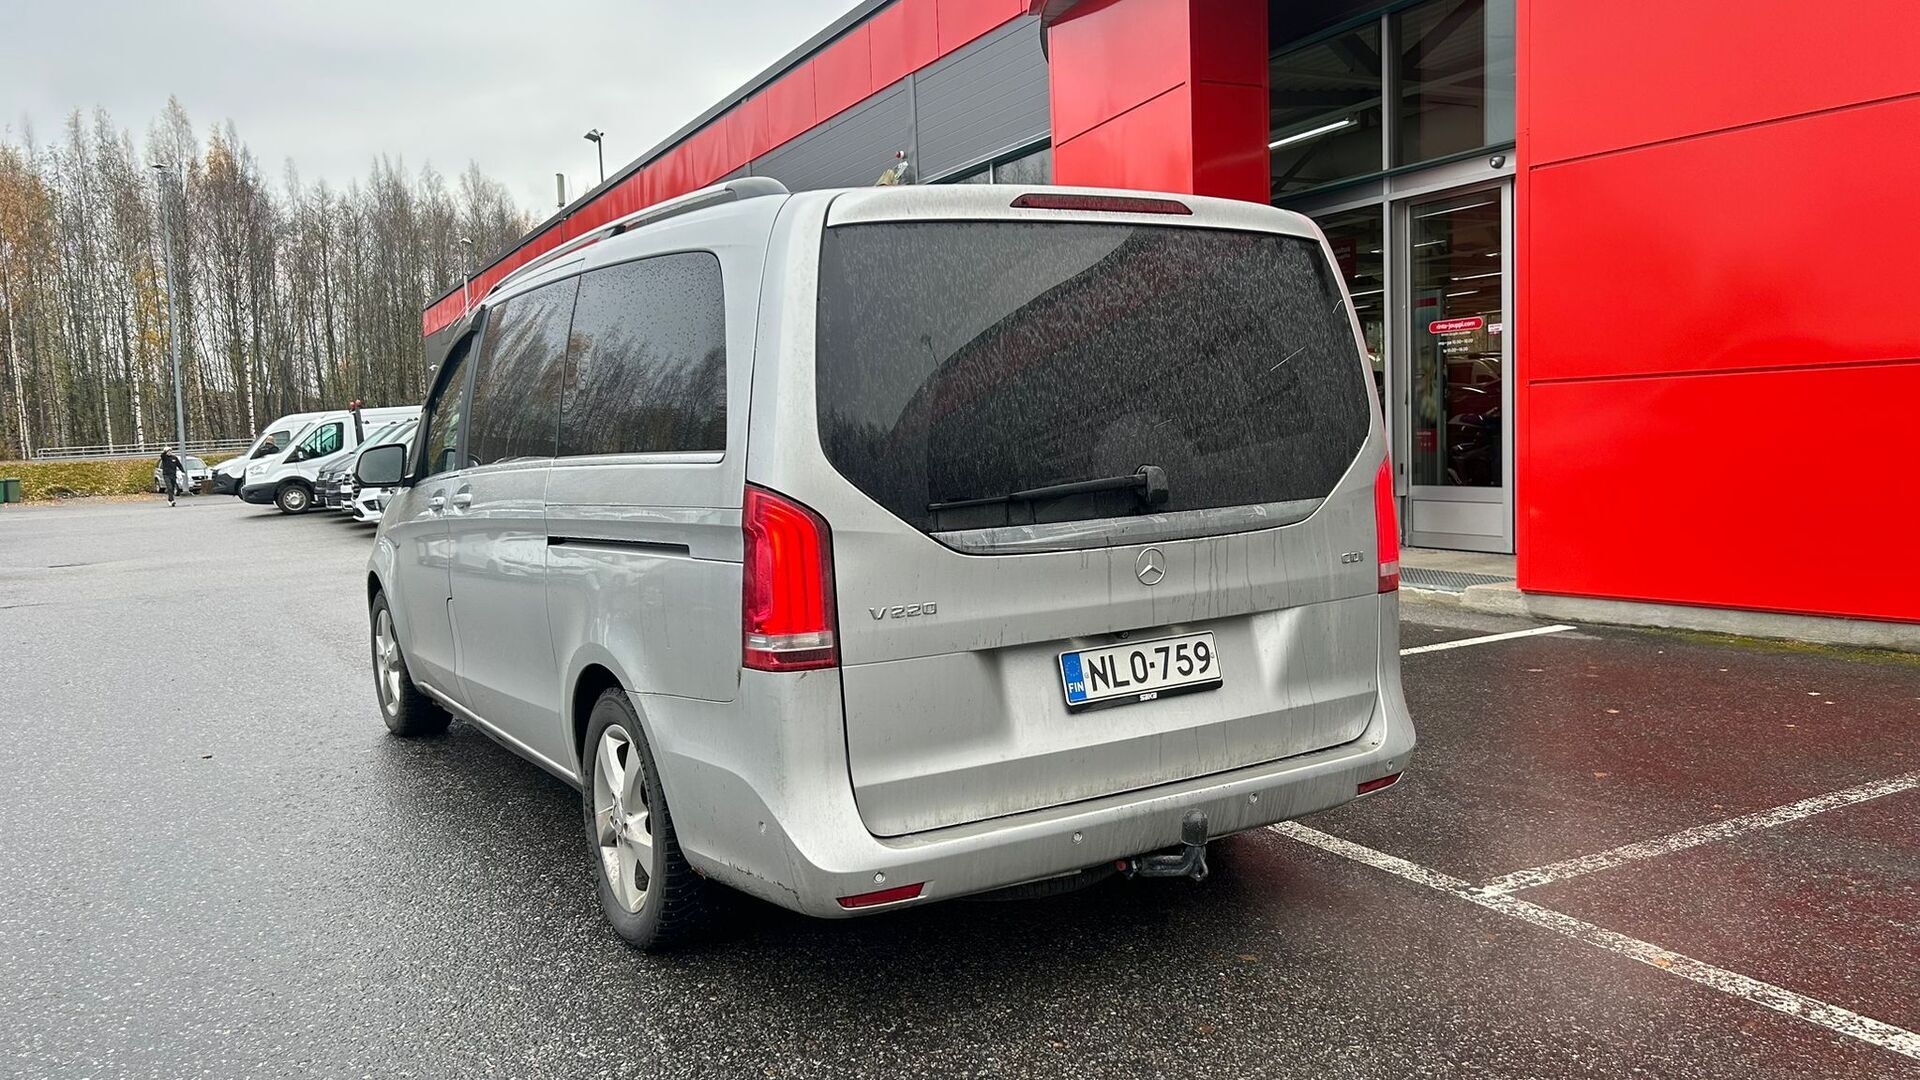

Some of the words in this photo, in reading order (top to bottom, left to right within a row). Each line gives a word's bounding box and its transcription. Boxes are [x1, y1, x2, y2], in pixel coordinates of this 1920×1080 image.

[868, 607, 887, 620] V
[891, 601, 937, 619] 220
[1087, 641, 1211, 692] NLO-759
[1069, 681, 1085, 694] FIN
